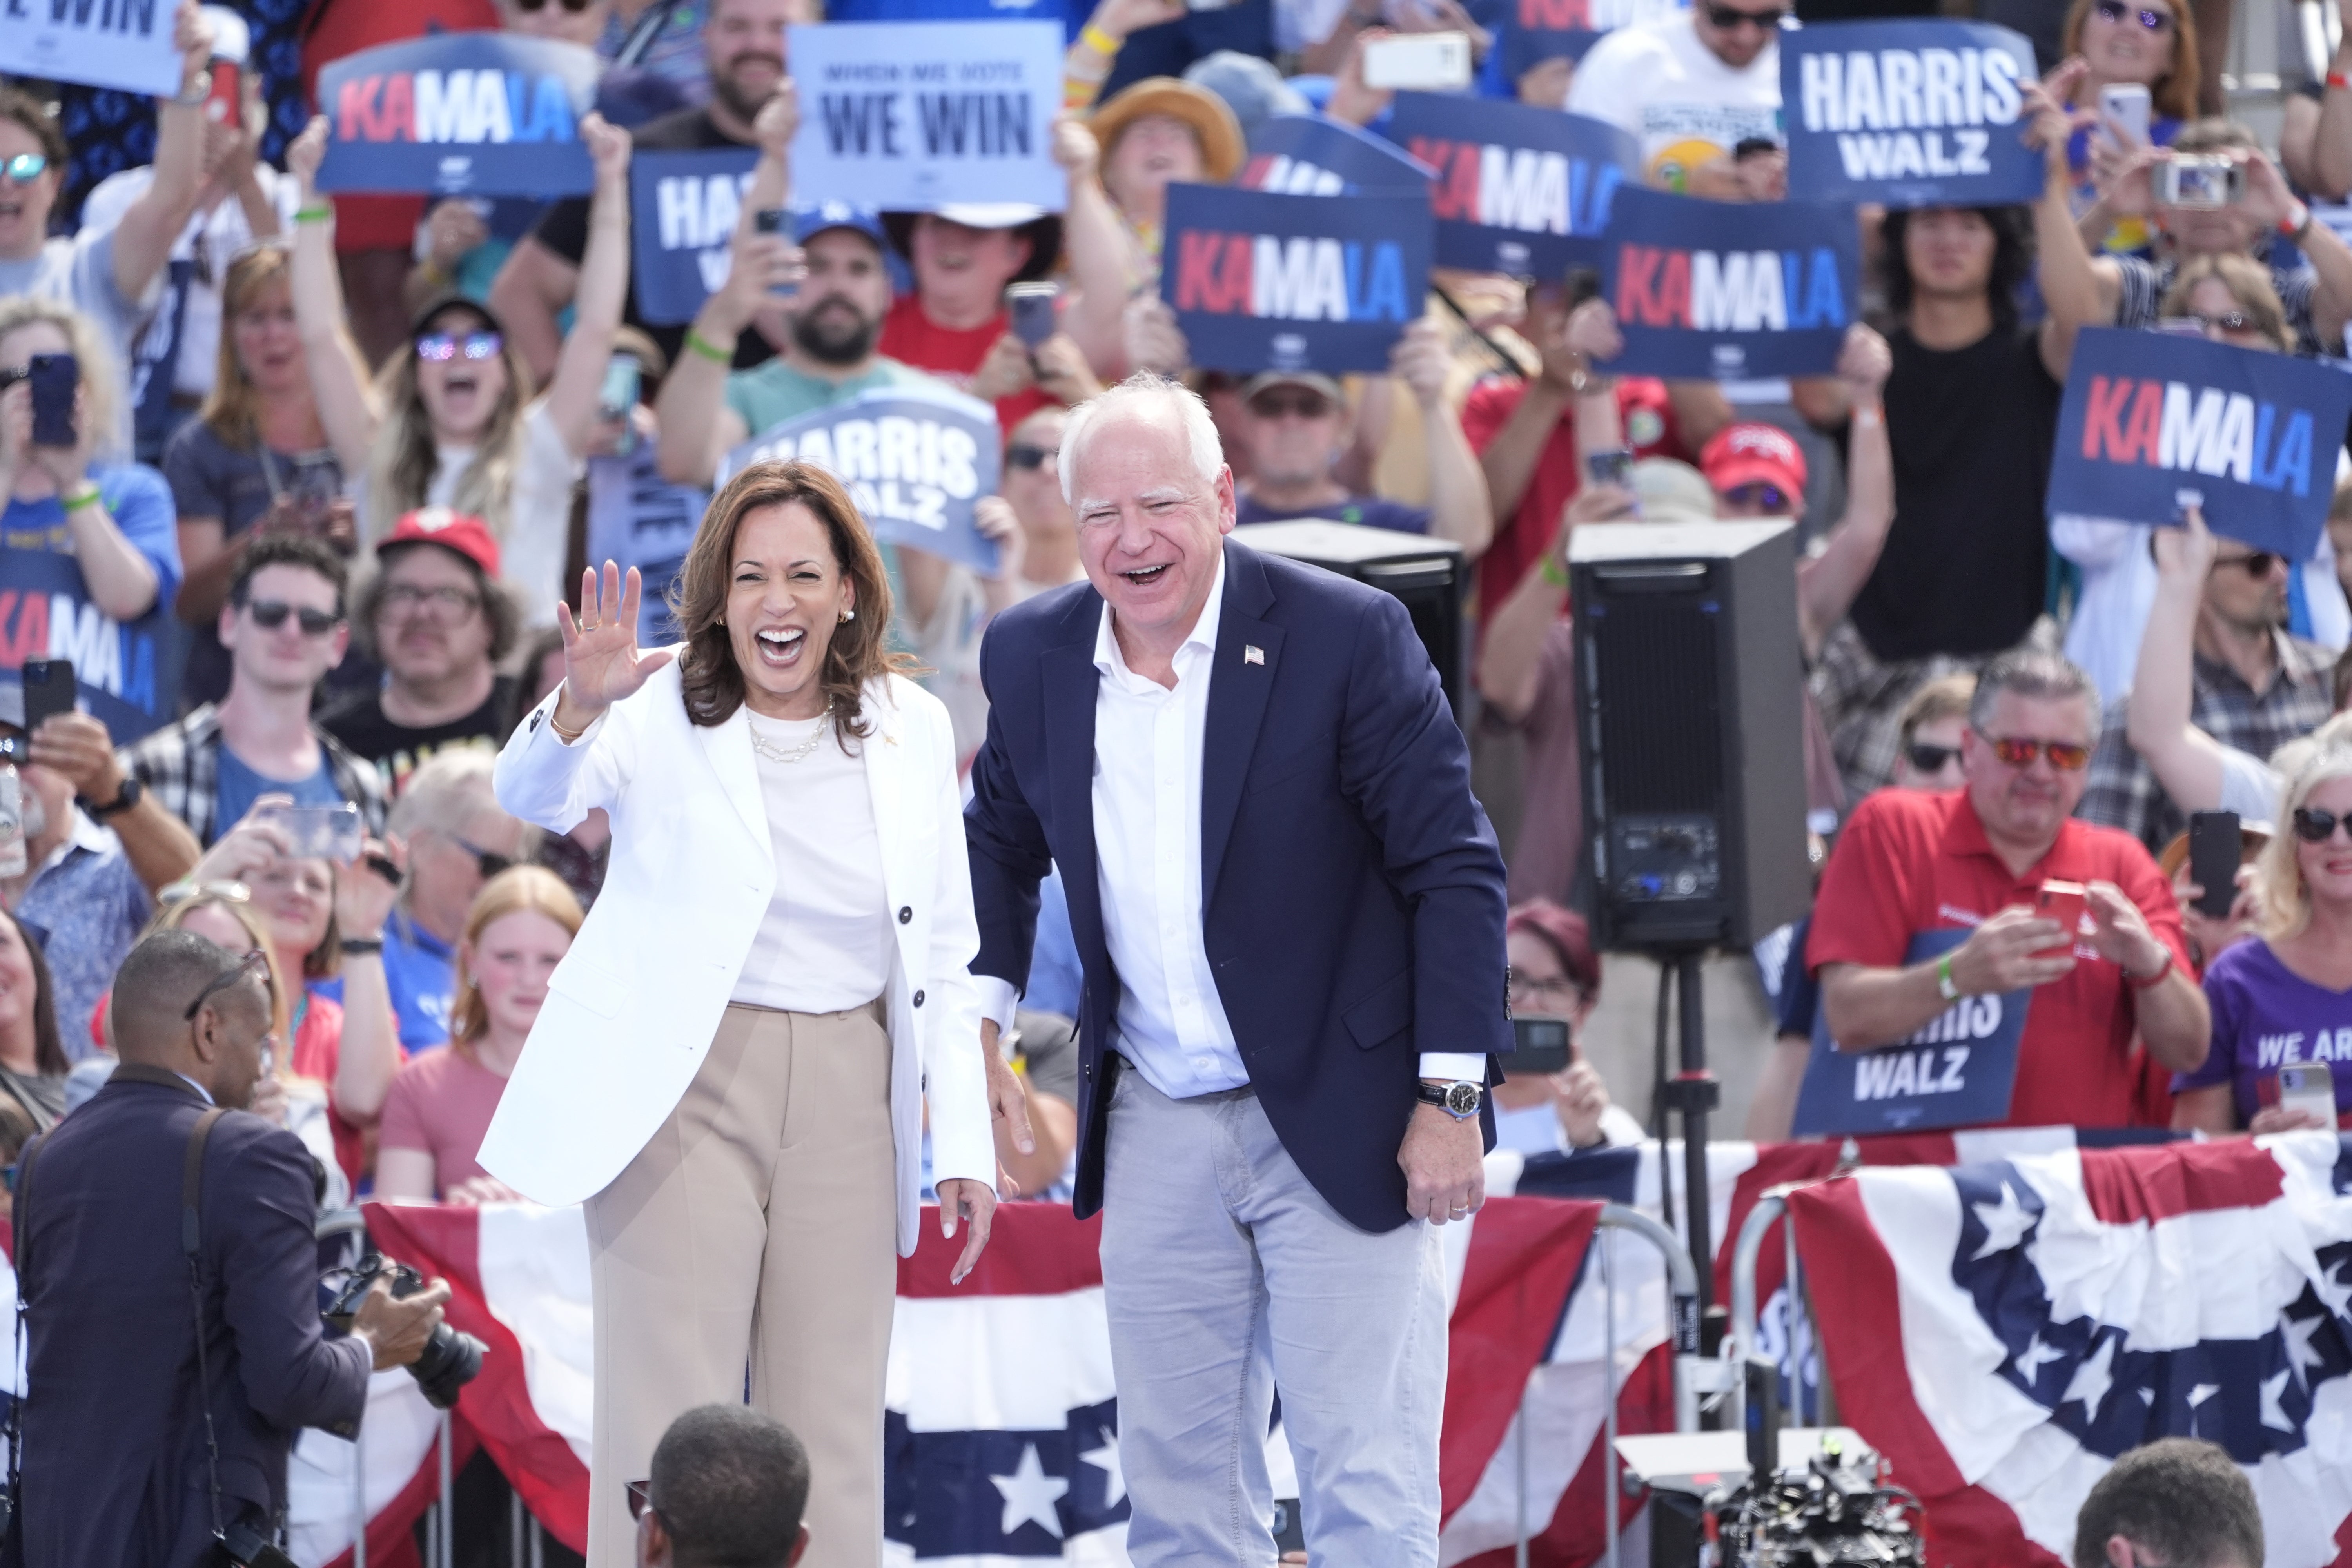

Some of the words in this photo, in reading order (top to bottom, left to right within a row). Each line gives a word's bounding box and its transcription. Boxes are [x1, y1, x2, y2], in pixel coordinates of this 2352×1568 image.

[338, 69, 573, 143] KAMALA
[1802, 47, 2024, 132] HARRIS
[821, 93, 903, 156] WE
[916, 93, 1031, 156] WIN
[1838, 129, 1991, 181] WALZ
[1175, 230, 1409, 323] KAMALA
[1616, 244, 1846, 332] KAMALA
[2082, 375, 2314, 498] KAMALA
[850, 481, 948, 531] ALZ
[1854, 1044, 1971, 1102] WALZ
[2257, 1032, 2305, 1069] WE
[2311, 1028, 2352, 1062] AR
